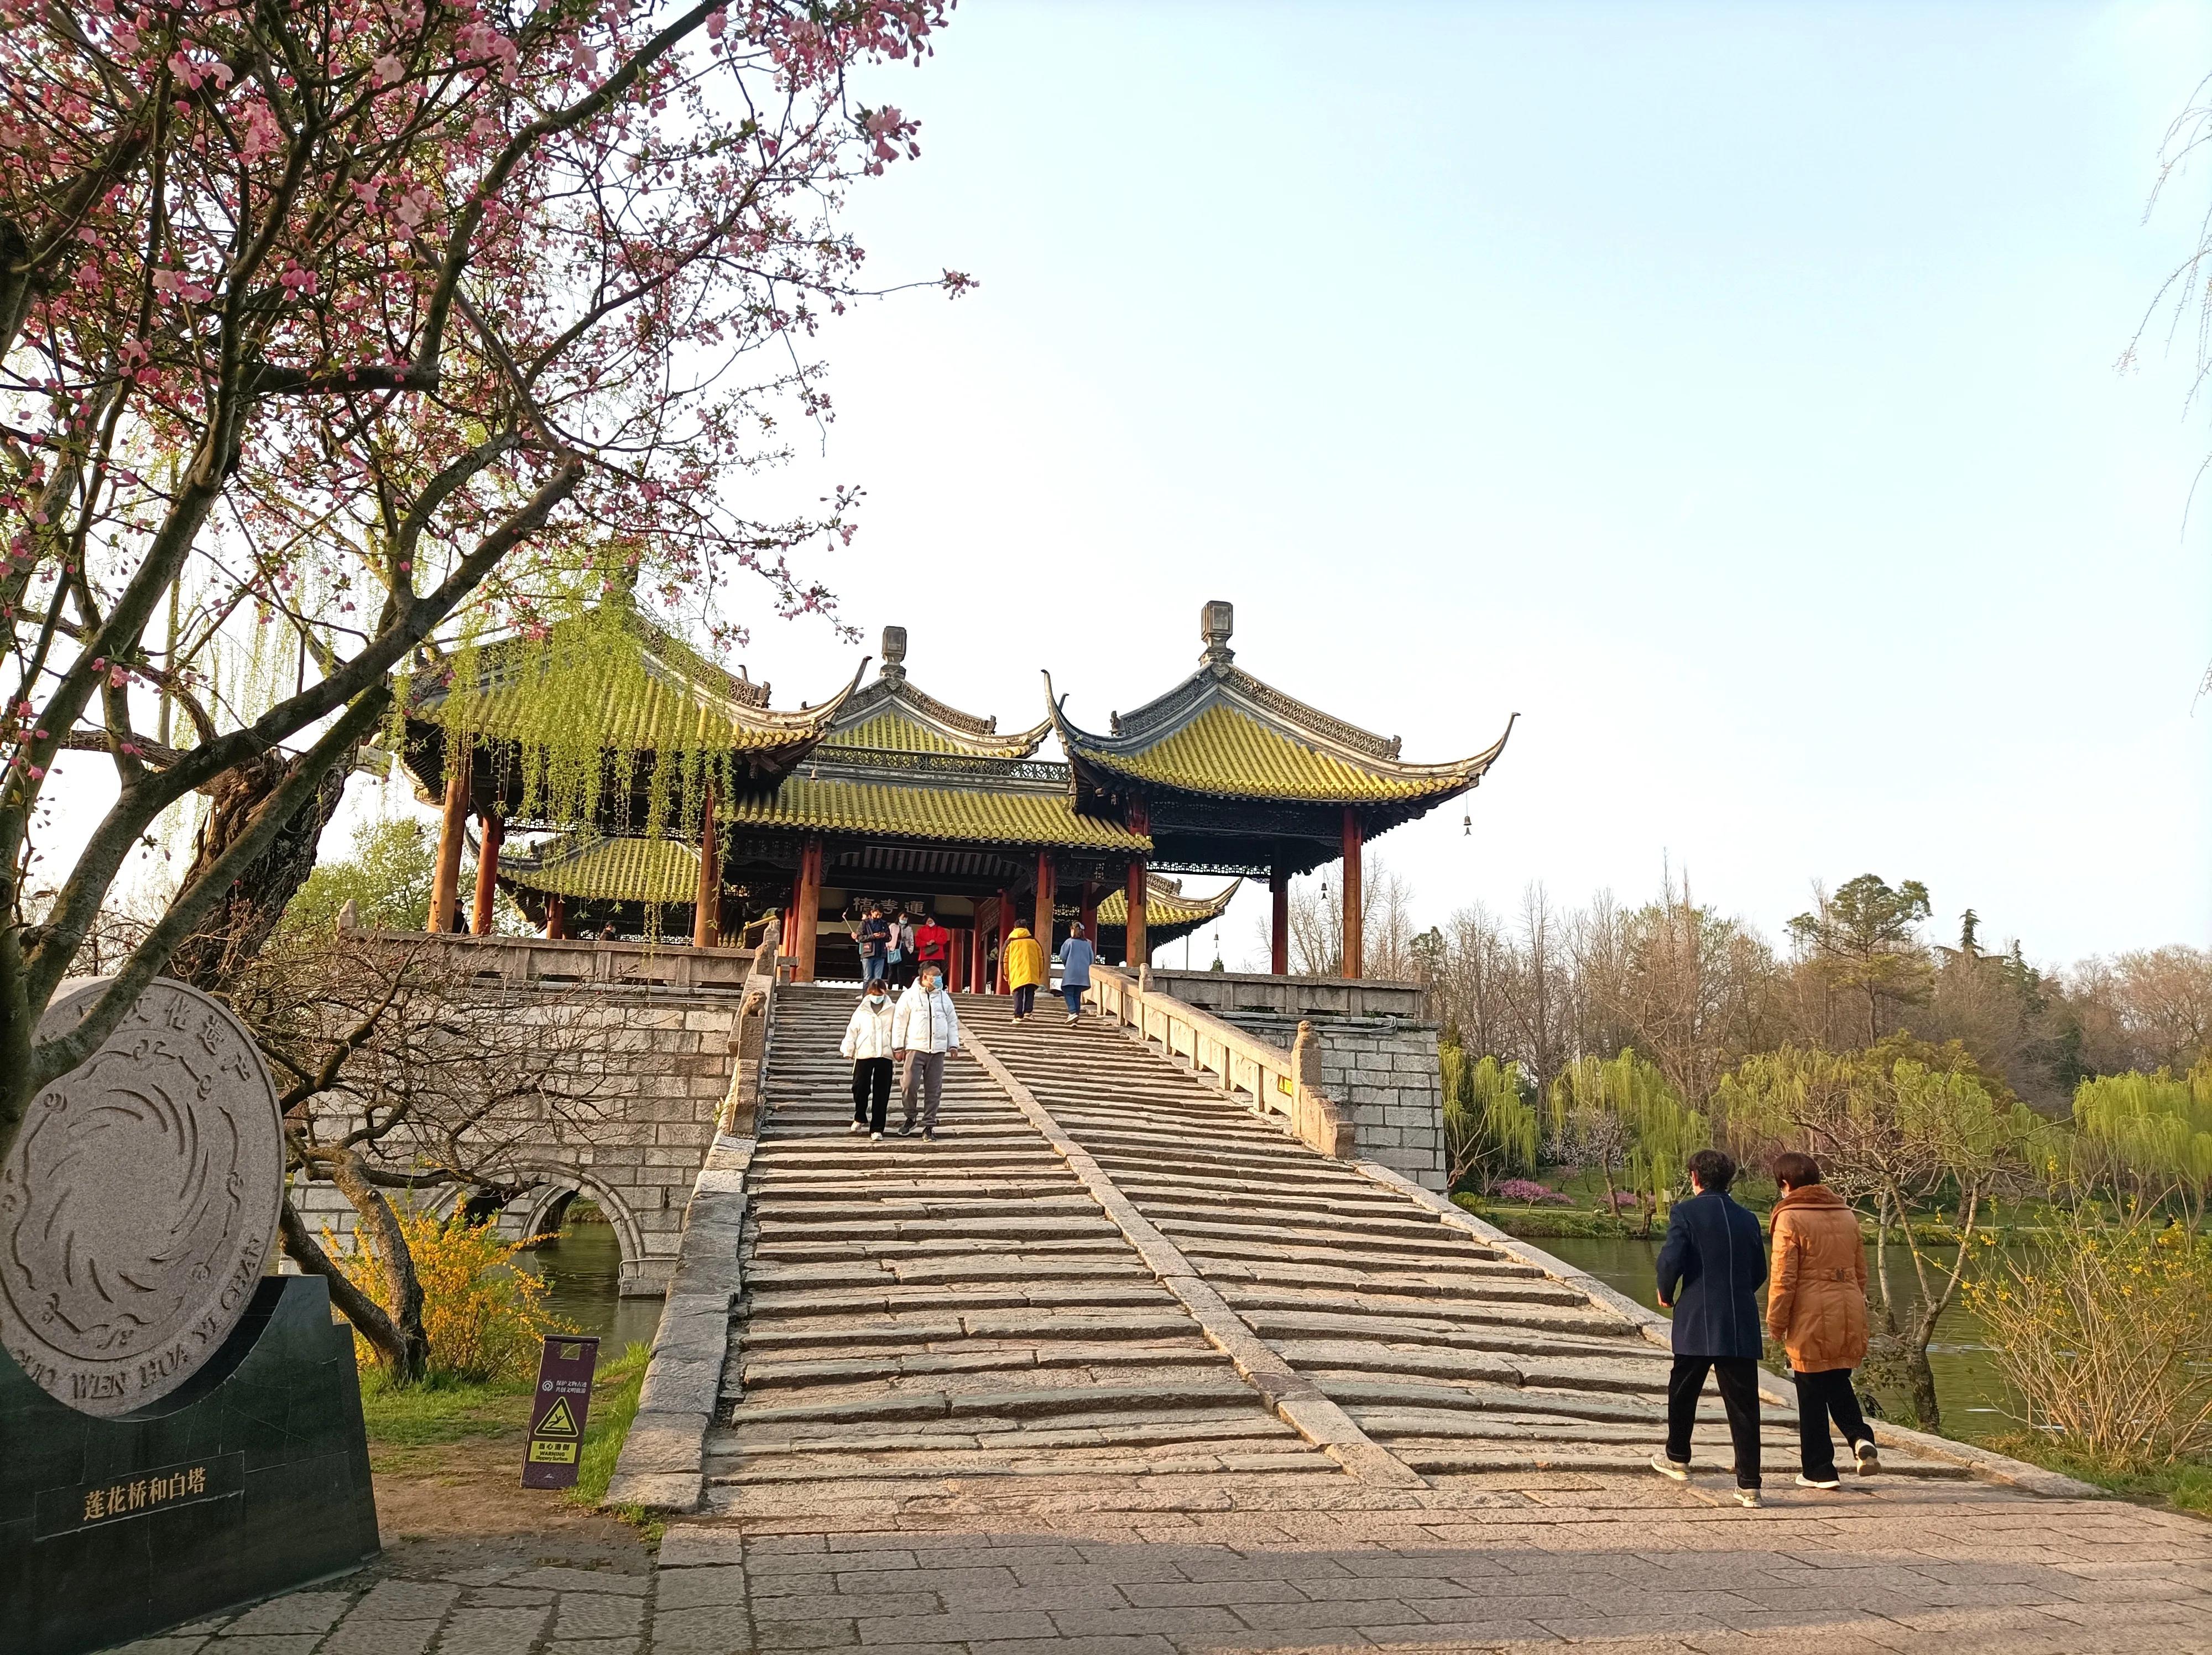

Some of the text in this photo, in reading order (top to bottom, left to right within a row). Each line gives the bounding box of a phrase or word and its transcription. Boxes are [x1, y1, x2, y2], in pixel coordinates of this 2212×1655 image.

[71, 1371, 126, 1399] WEN
[138, 1343, 189, 1388] HUA
[84, 1467, 206, 1521] 莲花桥和白塔
